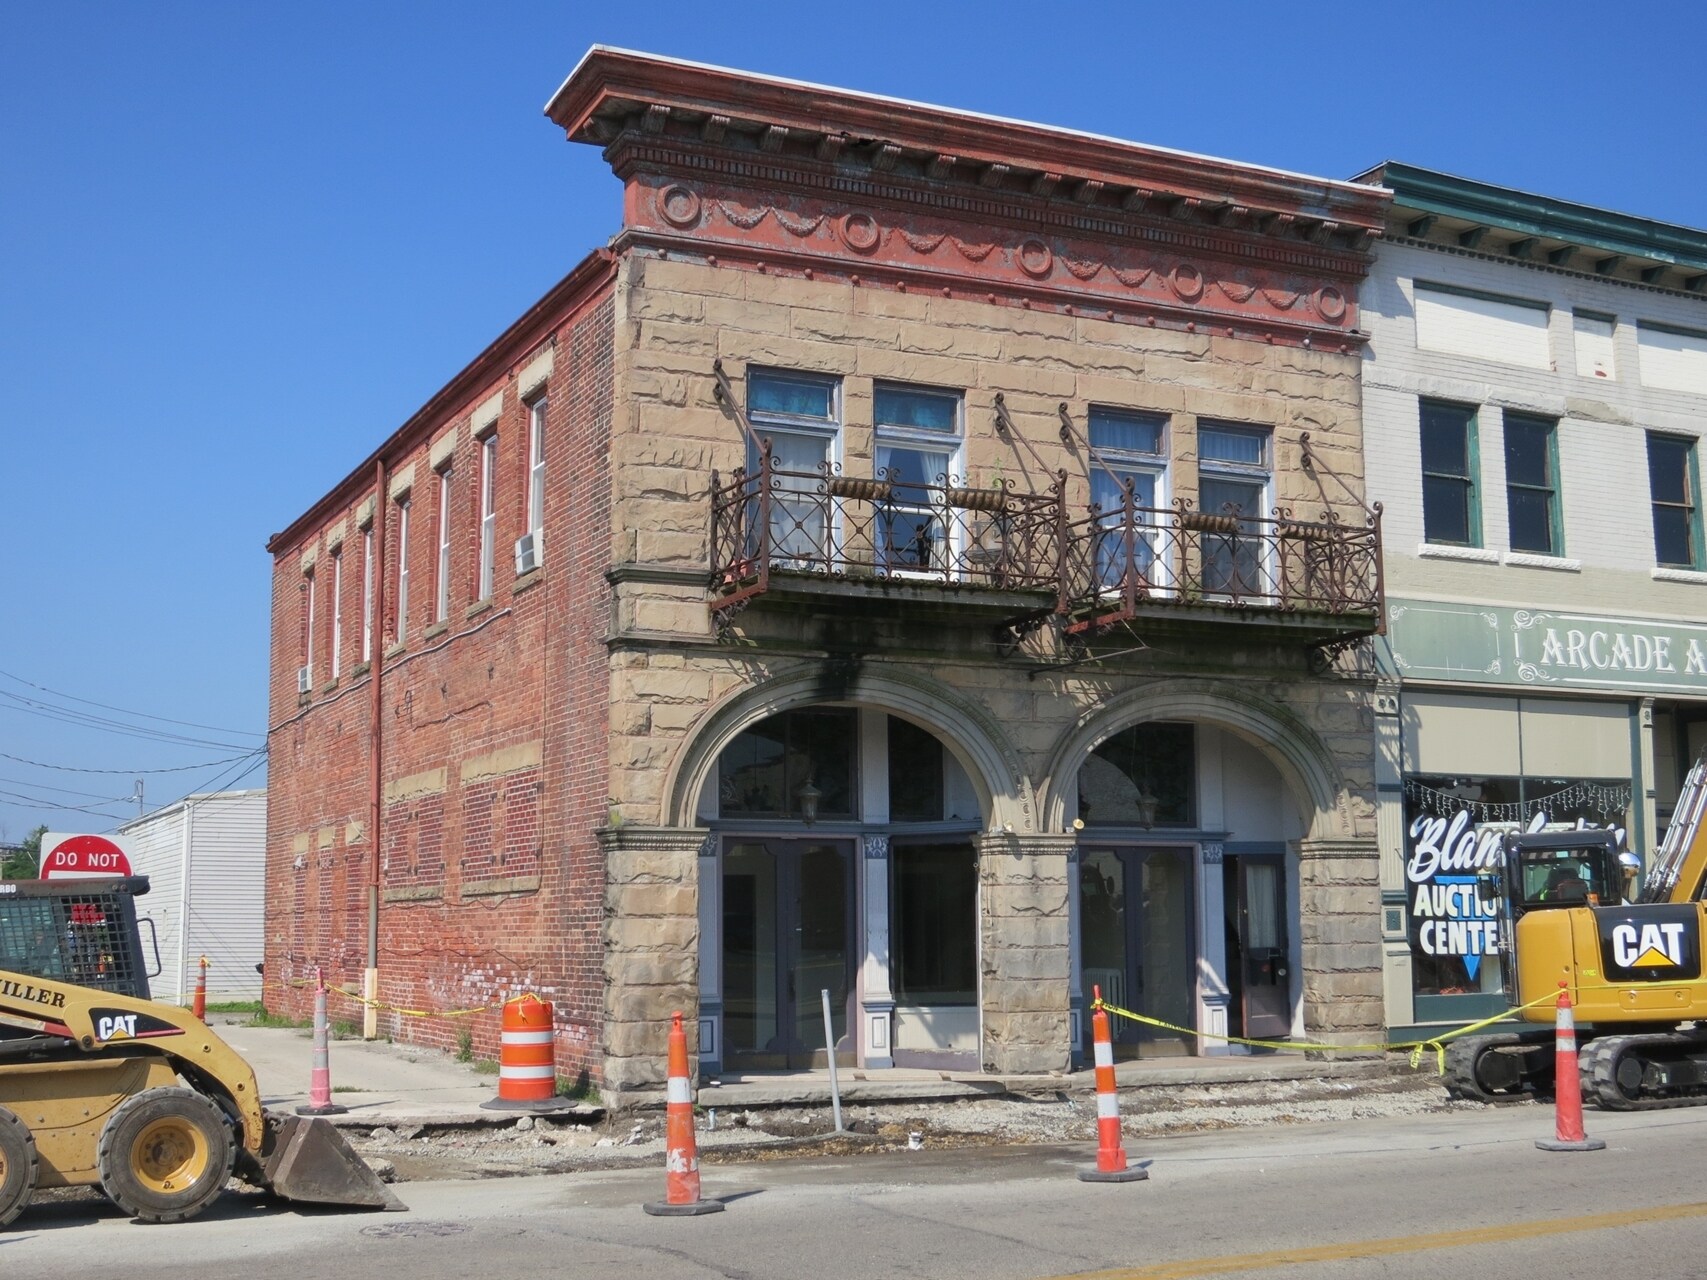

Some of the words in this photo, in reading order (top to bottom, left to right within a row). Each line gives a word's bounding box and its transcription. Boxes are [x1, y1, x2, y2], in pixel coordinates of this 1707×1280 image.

[1540, 628, 1677, 673] ARCADE
[1684, 638, 1707, 675] A
[55, 851, 78, 867] DO
[87, 852, 119, 868] NOT
[1412, 883, 1504, 918] AUCTIO
[1419, 919, 1504, 956] CENTE
[1611, 922, 1685, 968] CAT
[0, 979, 67, 1009] ILLER
[98, 1014, 138, 1041] CAT
